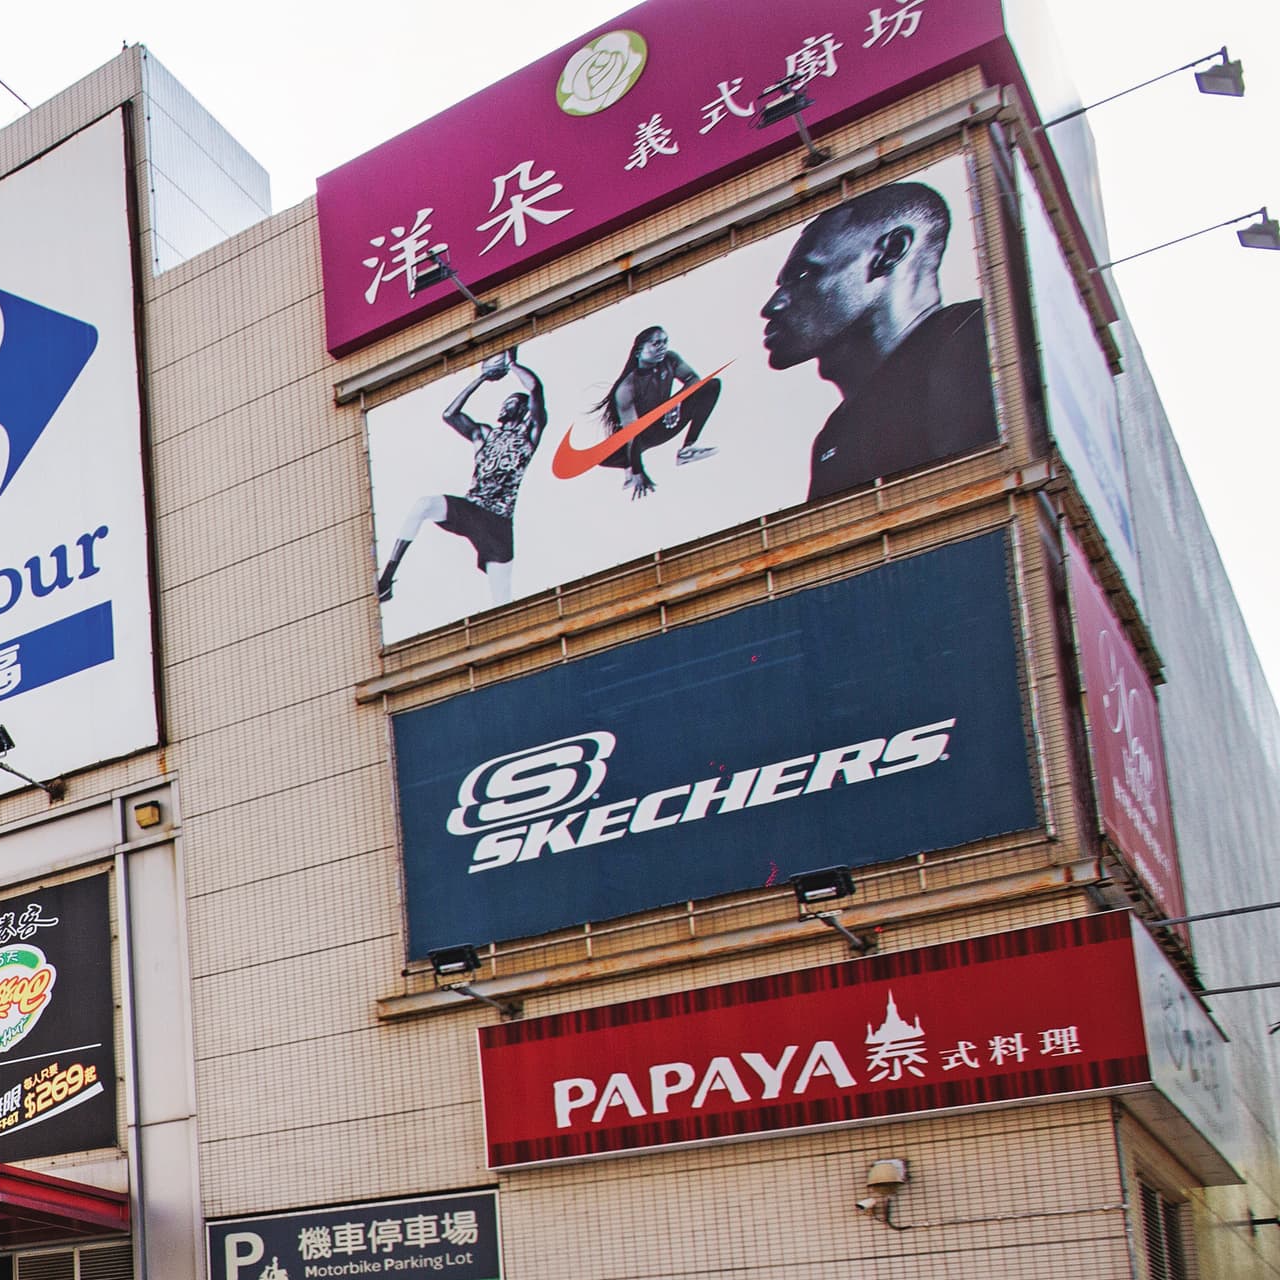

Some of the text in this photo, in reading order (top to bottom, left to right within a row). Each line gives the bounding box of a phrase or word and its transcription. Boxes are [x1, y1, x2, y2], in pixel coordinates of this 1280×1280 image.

[363, 158, 573, 304] 洋朵
[468, 717, 957, 874] SKECHERS
[553, 1041, 857, 1128] PAPAYA
[297, 1208, 479, 1261] 機車停車場
[304, 1250, 473, 1278] Motorbike Parking Lot
